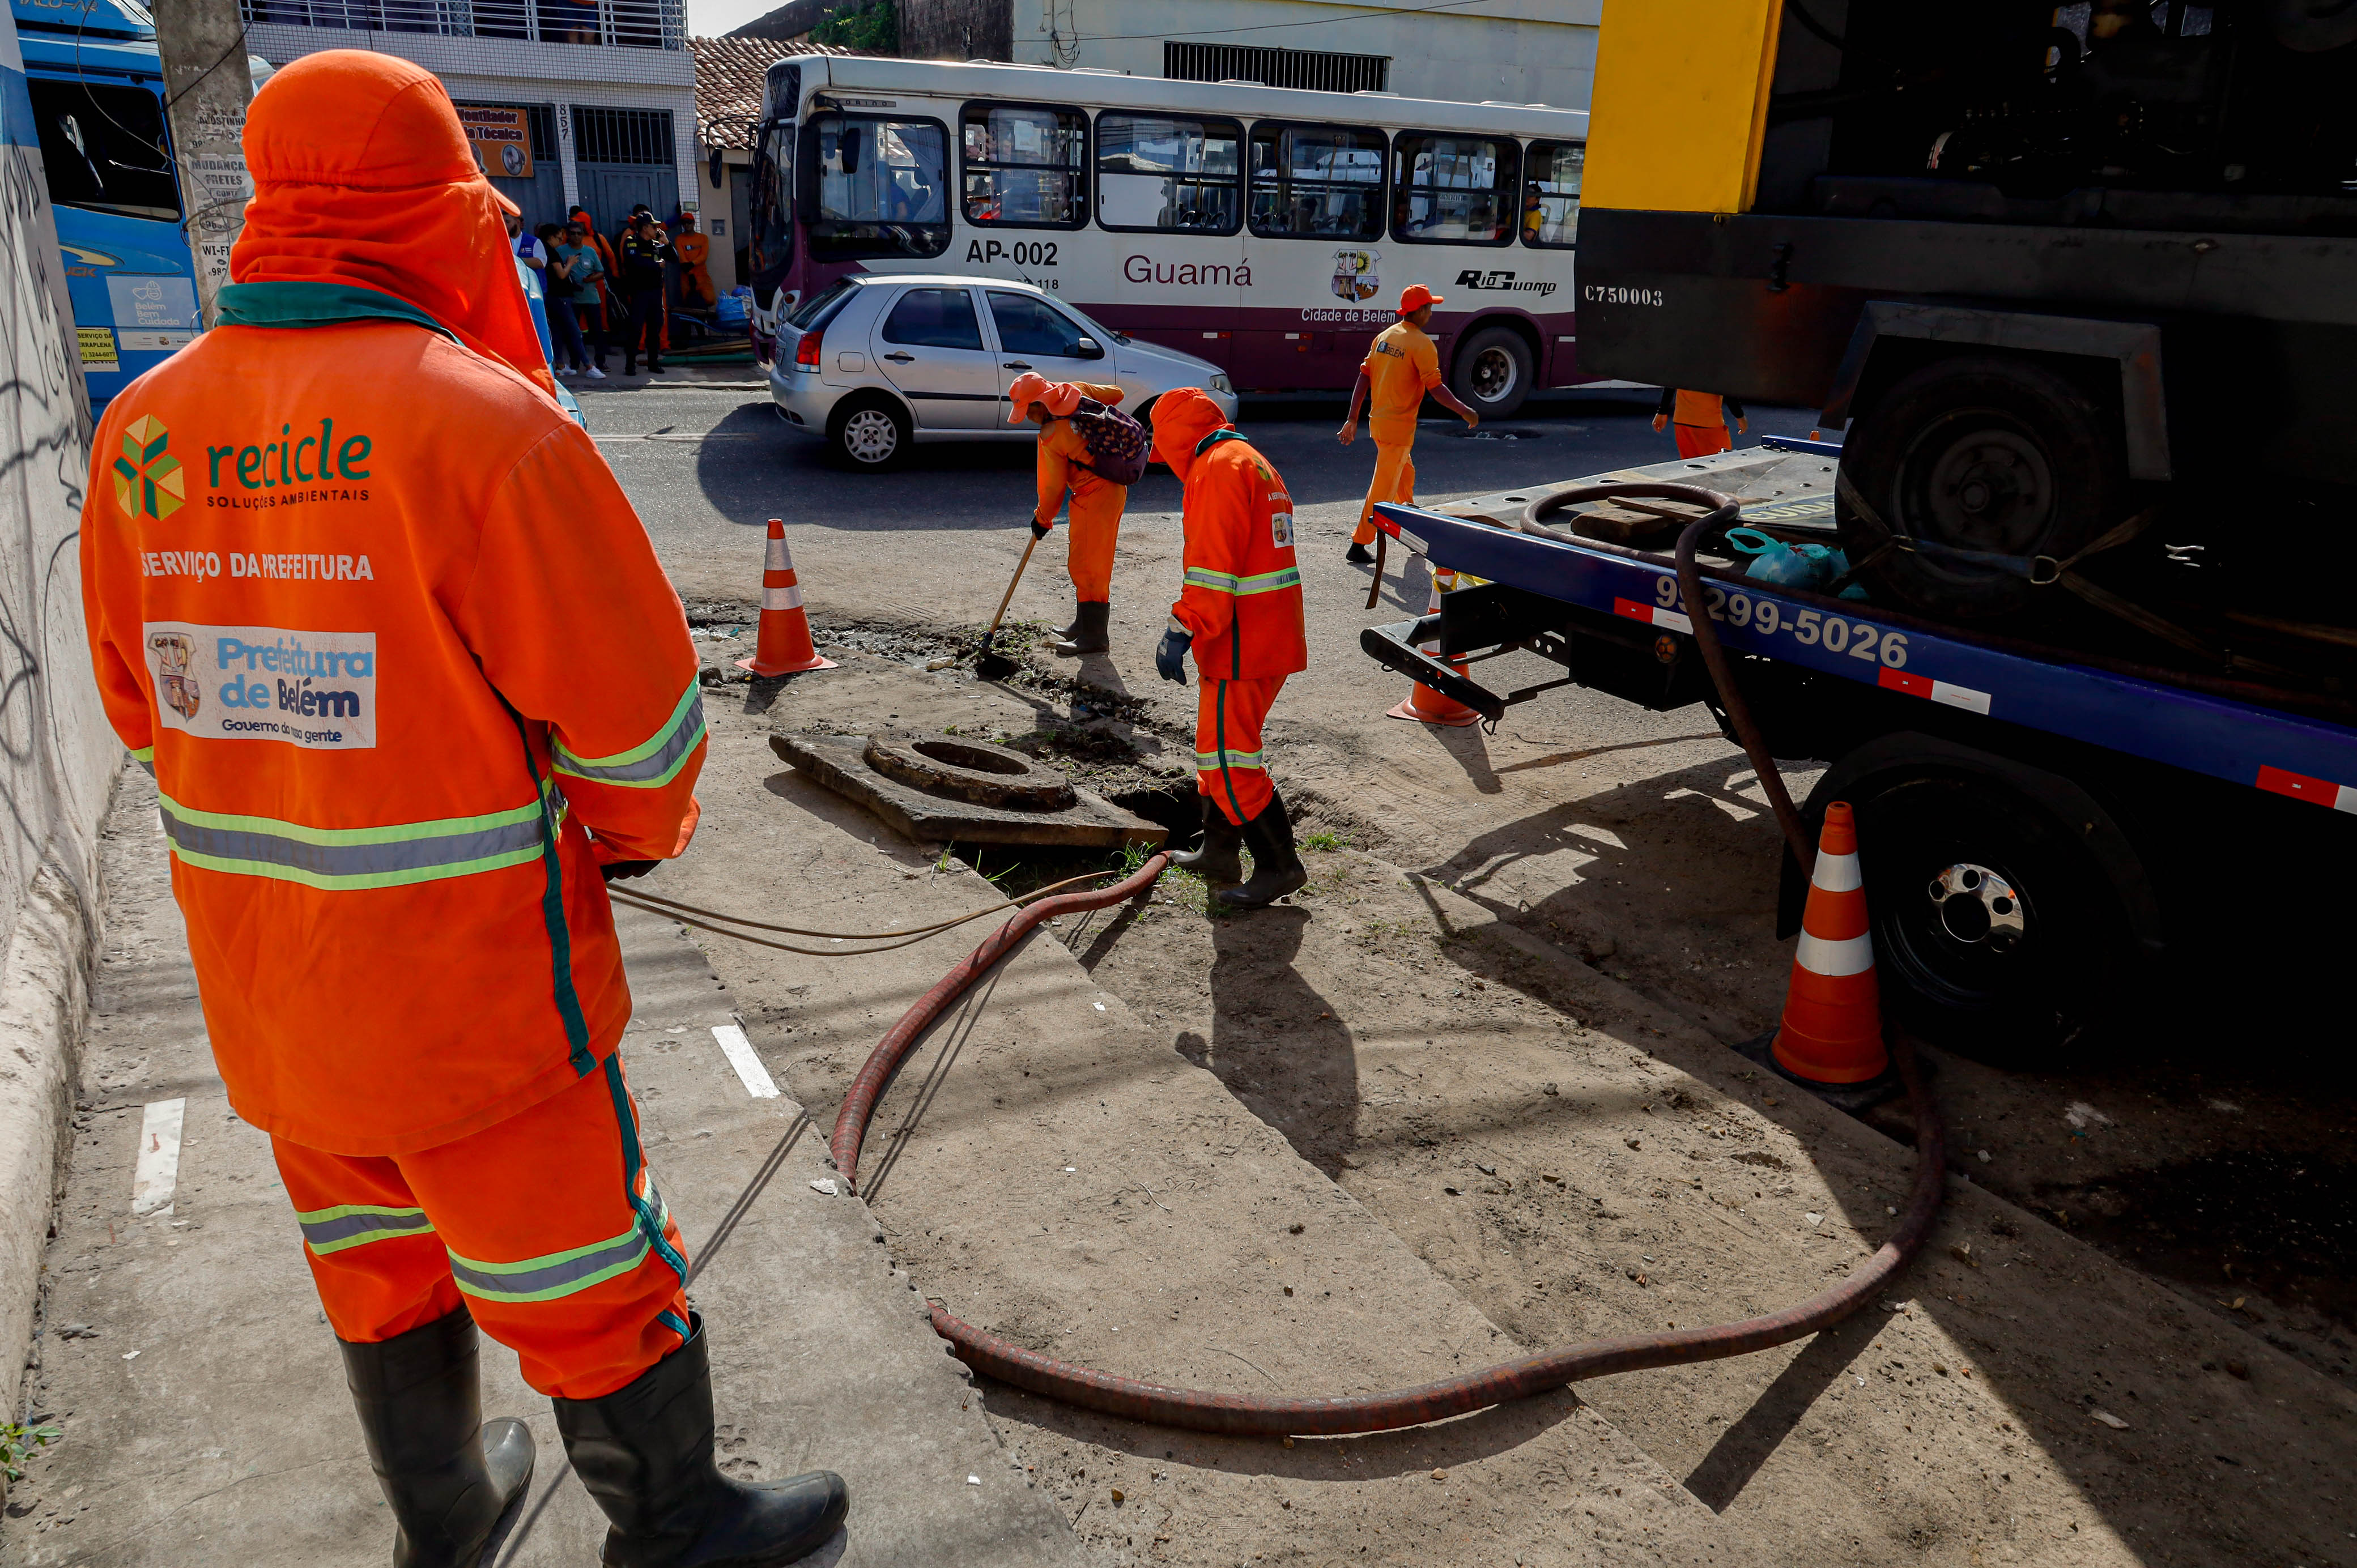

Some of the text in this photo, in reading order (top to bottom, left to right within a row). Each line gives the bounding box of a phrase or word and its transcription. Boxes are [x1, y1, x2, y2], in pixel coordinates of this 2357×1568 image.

[476, 126, 524, 142] Técnica
[192, 160, 248, 173] MUDANÇA
[205, 174, 243, 185] FRETES
[202, 245, 230, 256] WI-FI
[966, 240, 1058, 266] AP-002
[1124, 254, 1253, 287] Guamá
[135, 302, 167, 310] Belém
[1585, 285, 1663, 307] C750003
[1301, 308, 1396, 323] Cidade de Belém
[1386, 347, 1405, 360] BELÉM
[207, 418, 372, 489] recicle
[207, 489, 369, 511] SOLUÇÕES AMBIENTAIS
[141, 551, 374, 583] SERVIÇO DA PREFEITURA
[218, 636, 373, 678] Prefeitura
[220, 674, 360, 717] de Belém
[222, 719, 279, 733] Governo
[305, 729, 342, 744] gente
